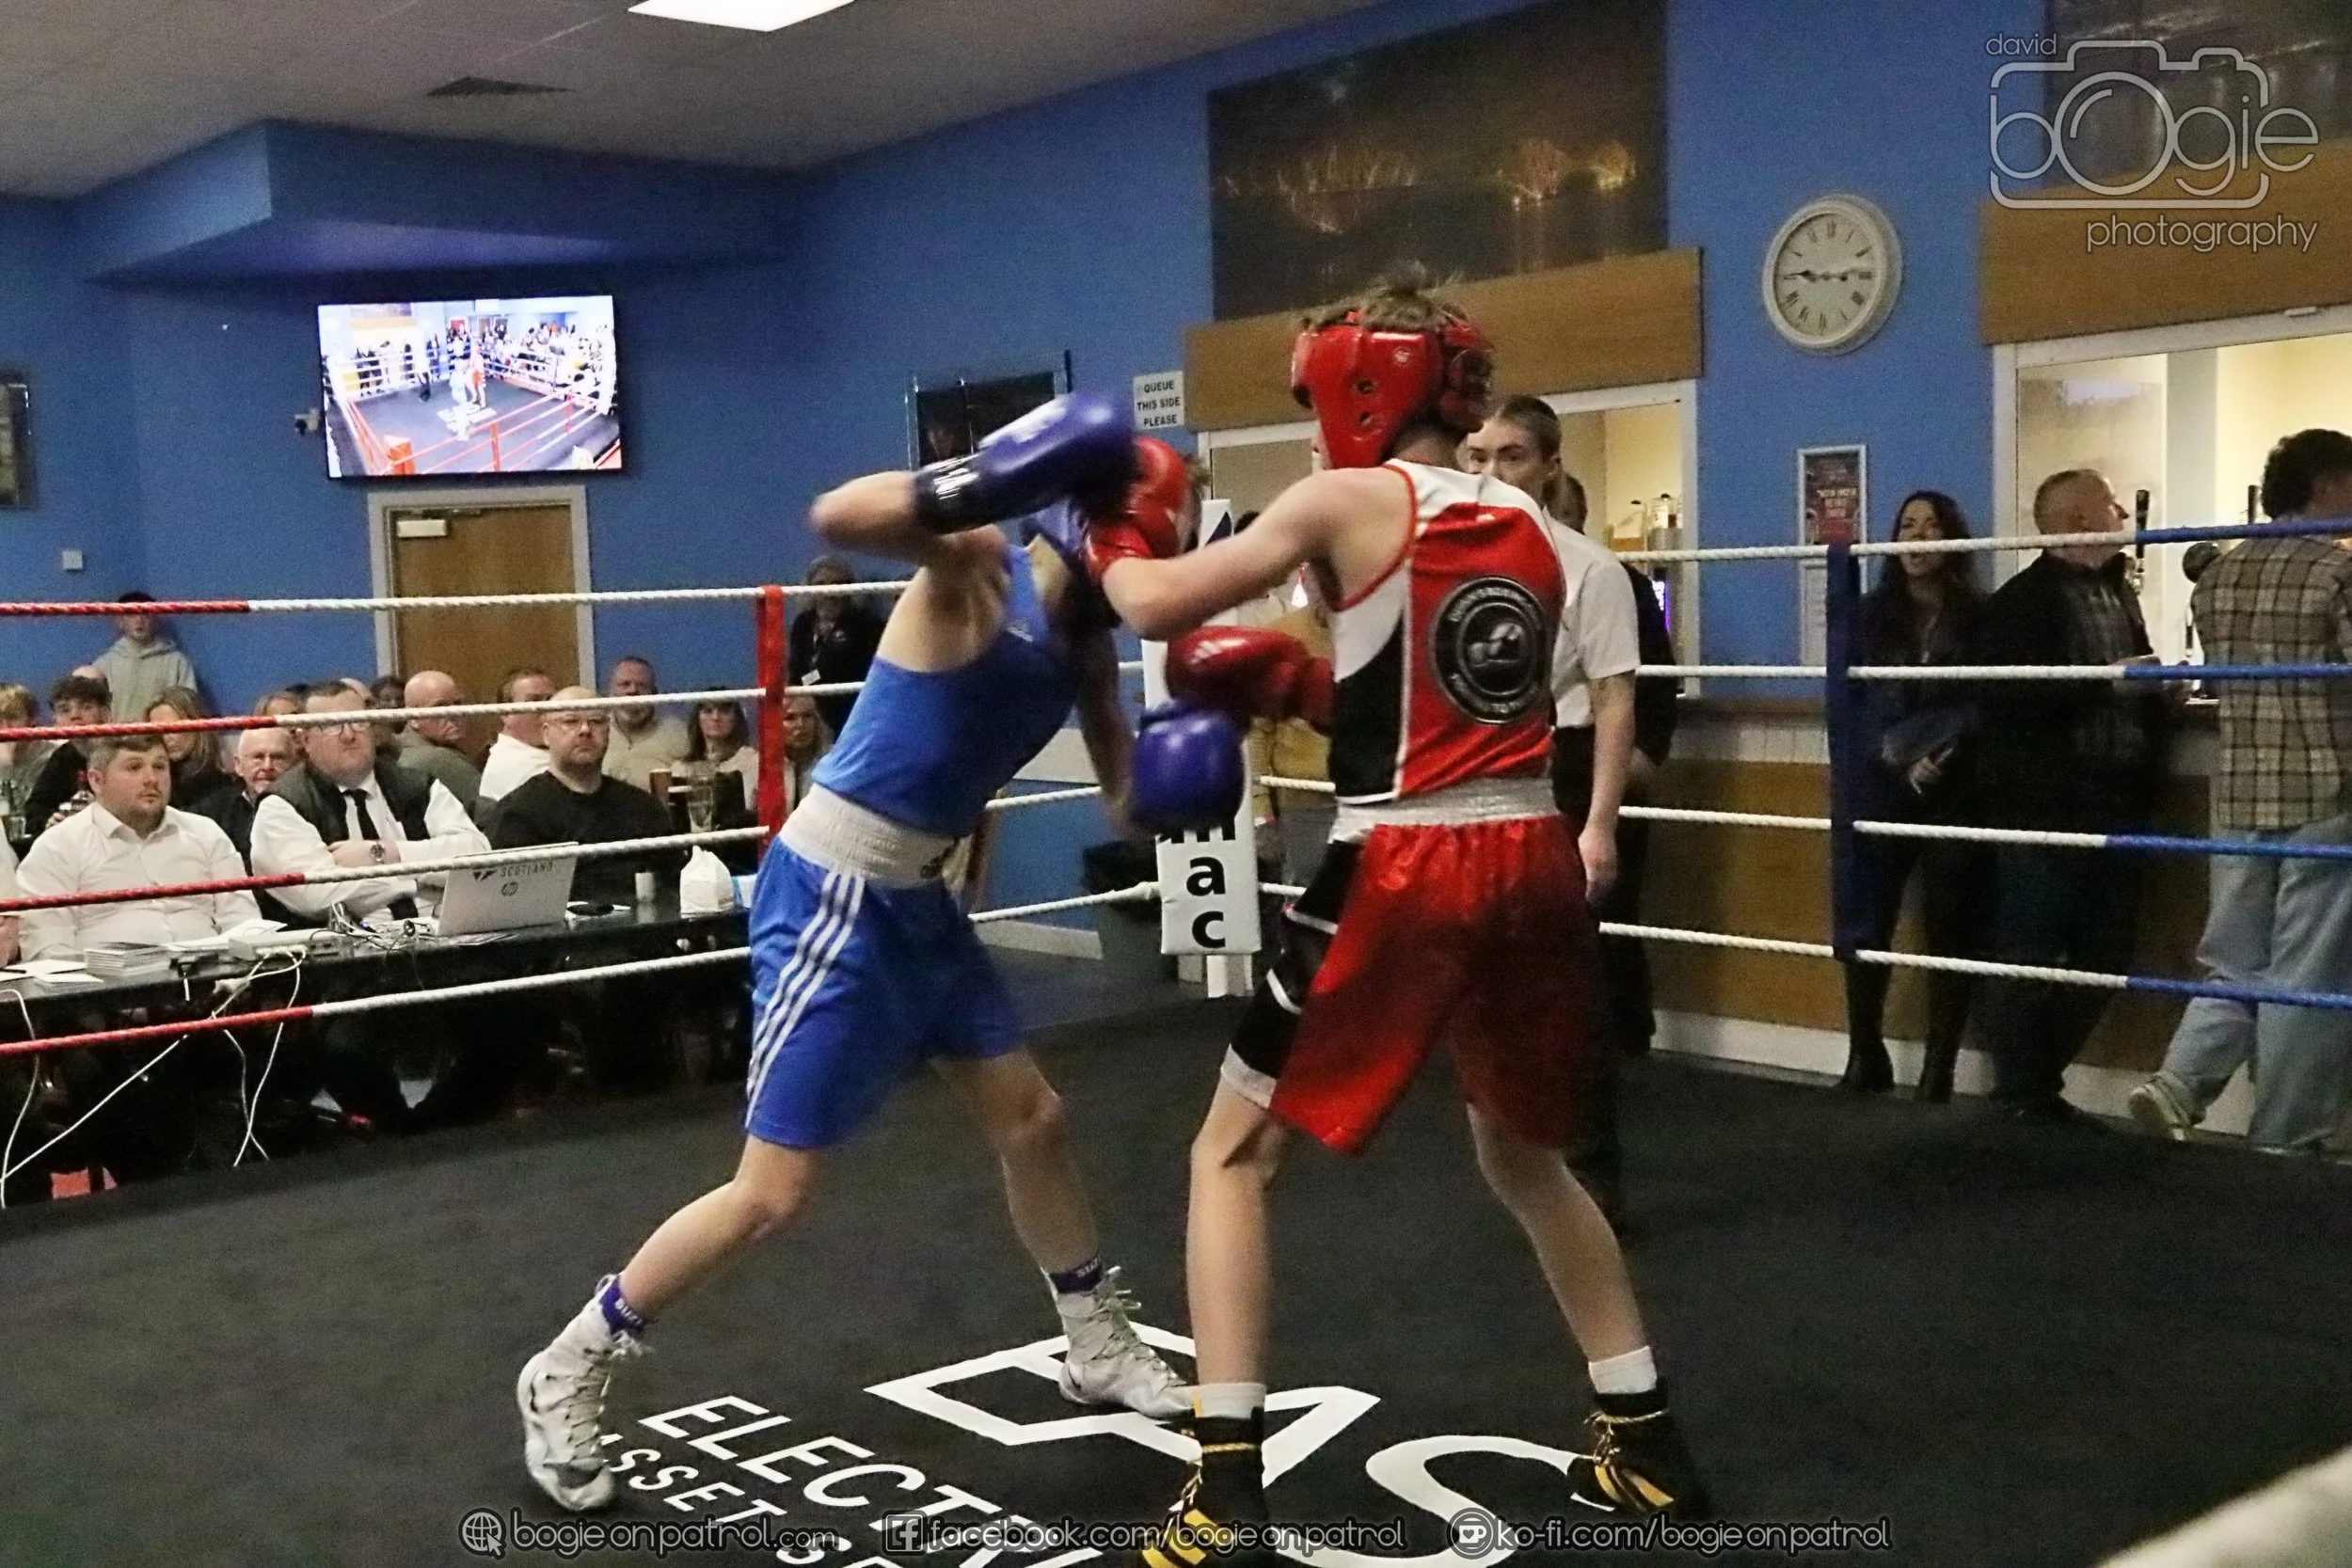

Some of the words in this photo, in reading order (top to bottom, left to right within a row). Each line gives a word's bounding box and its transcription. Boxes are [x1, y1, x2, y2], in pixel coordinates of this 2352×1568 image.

[1143, 380, 1174, 393] QUEUE
[1136, 400, 1157, 411] THIS
[1160, 396, 1181, 408] SIDE
[1143, 415, 1177, 427] PLEASE
[599, 1433, 787, 1525] SSET
